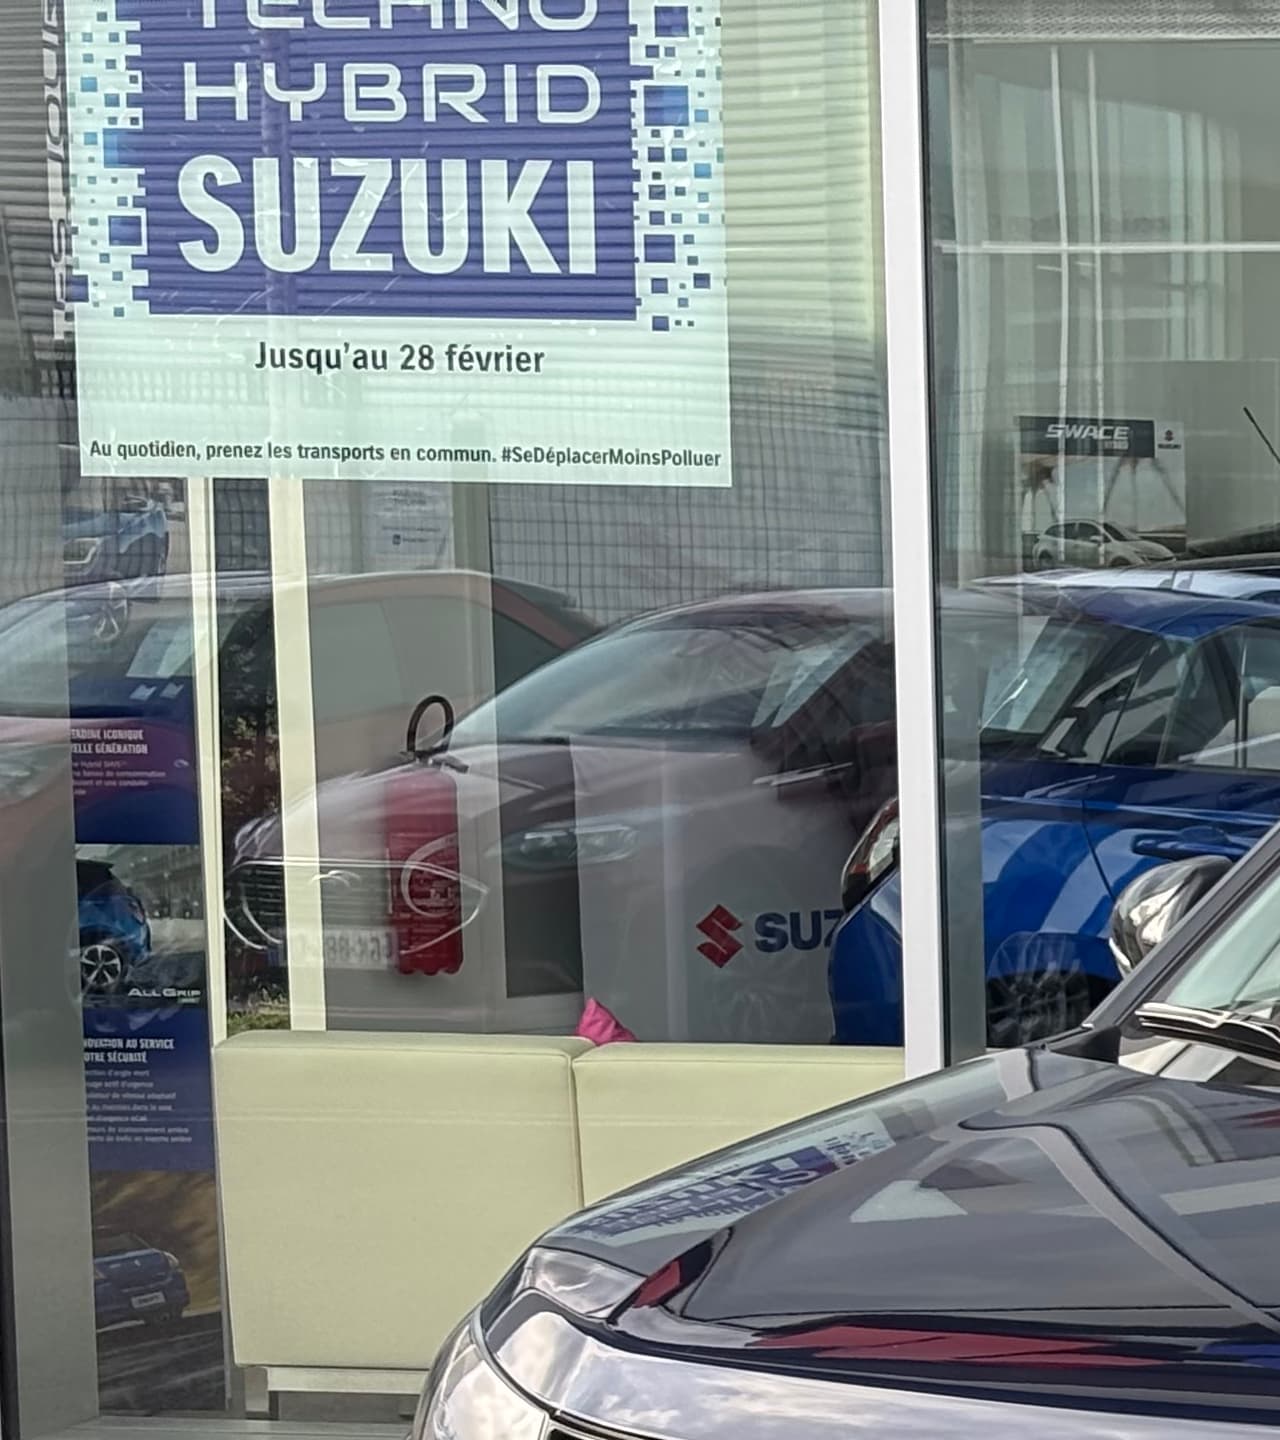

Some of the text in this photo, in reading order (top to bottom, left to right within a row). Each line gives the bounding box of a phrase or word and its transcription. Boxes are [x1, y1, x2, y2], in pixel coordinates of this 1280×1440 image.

[184, 62, 601, 123] HYBRID
[177, 154, 598, 274] SUZUKI
[255, 341, 545, 375] Jusqu'au 28 février
[90, 440, 722, 467] Au quotidien, prenez les transports en commun. #SeDéplacerMoinsPolluer
